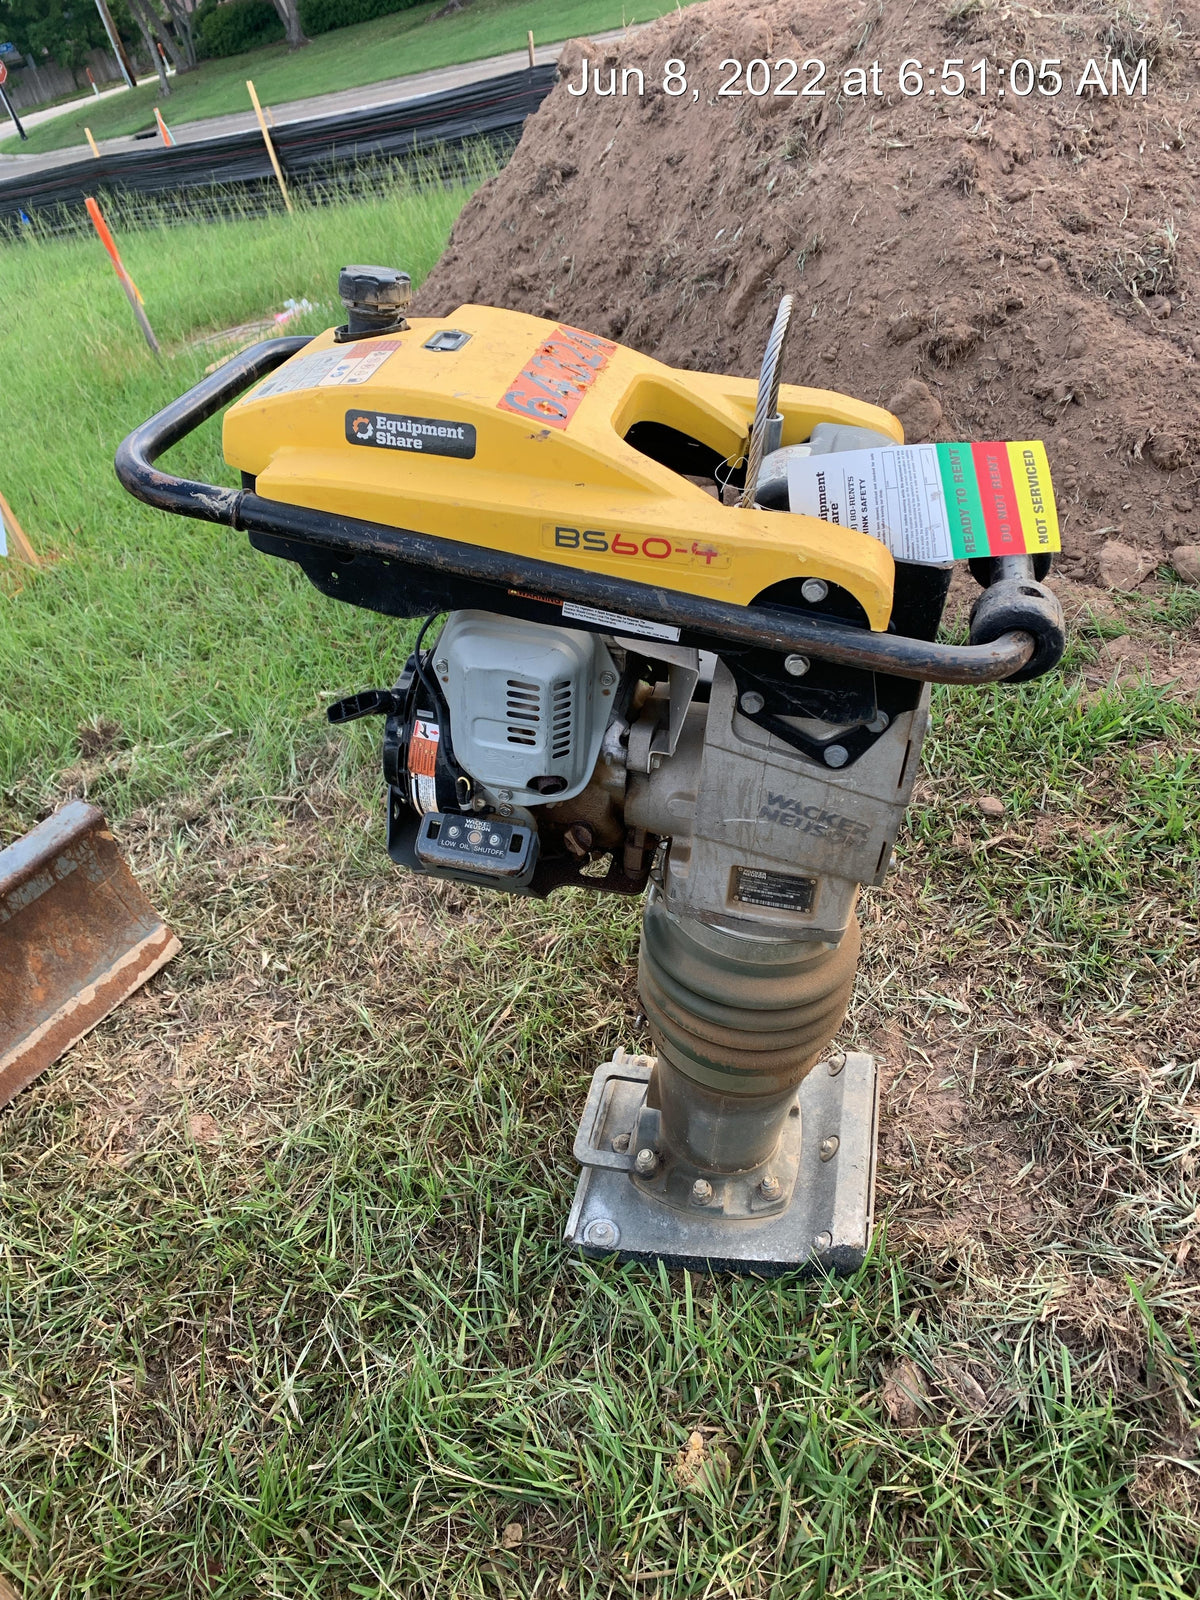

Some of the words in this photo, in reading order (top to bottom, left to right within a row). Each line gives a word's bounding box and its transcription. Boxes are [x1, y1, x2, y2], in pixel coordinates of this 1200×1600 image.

[375, 416, 465, 440] Equipment
[375, 431, 423, 449] Share
[948, 448, 964, 483] RENT
[986, 455, 1002, 489] RENT
[816, 471, 829, 522] ipment
[859, 479, 869, 513] SAFETY
[955, 488, 969, 505] TO
[1022, 449, 1045, 514] SERVICED
[830, 503, 840, 525] are
[994, 494, 1008, 519] NOT
[555, 526, 718, 565] BS60-4
[959, 508, 976, 554] READY
[1000, 524, 1012, 543] DO
[1035, 518, 1049, 545] NOT
[767, 790, 872, 842] WACKER
[441, 839, 457, 848] LOW
[459, 842, 470, 850] OIL
[473, 845, 505, 857] SHUTOFF
